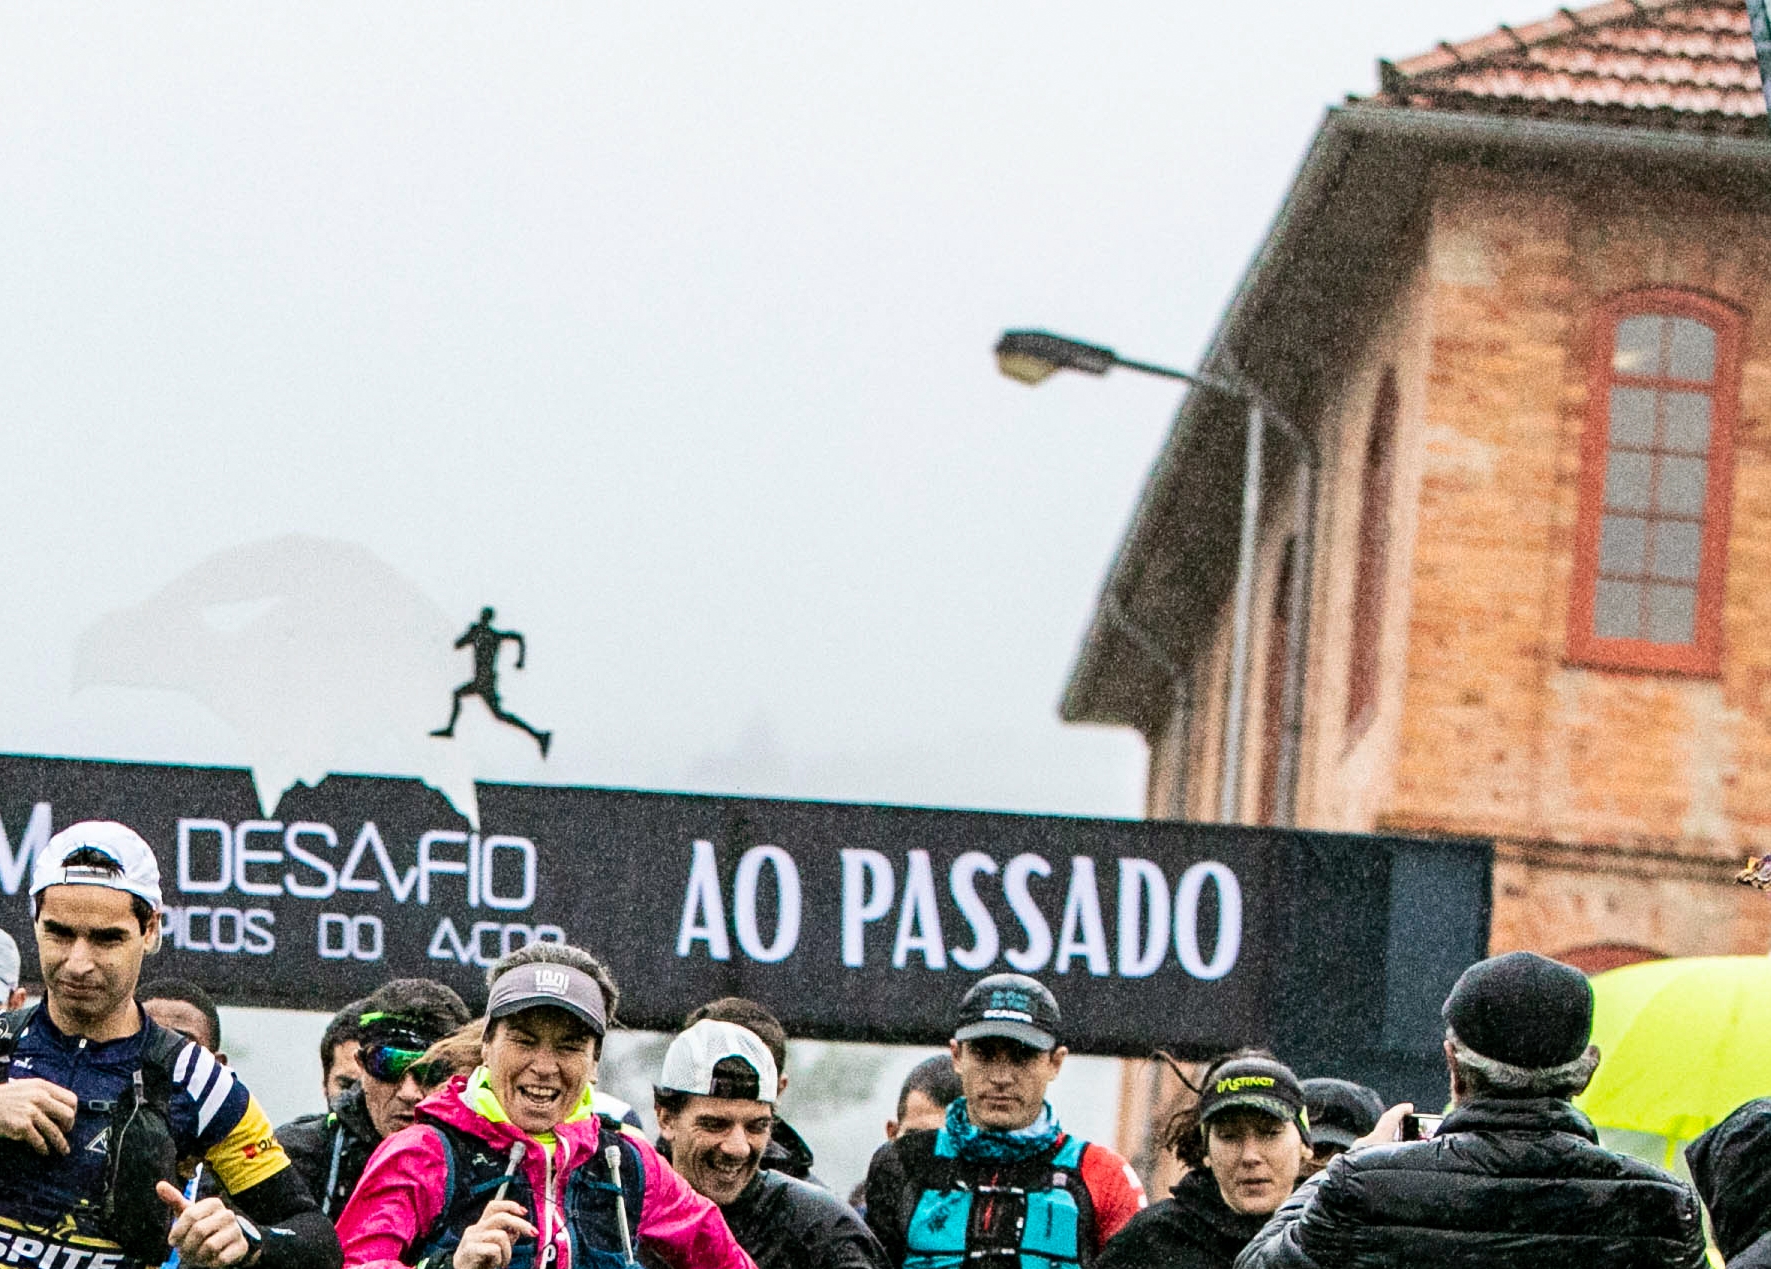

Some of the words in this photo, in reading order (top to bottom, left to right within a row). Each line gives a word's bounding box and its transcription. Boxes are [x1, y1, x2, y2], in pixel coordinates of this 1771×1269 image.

[177, 818, 537, 911] DESAFIO
[676, 839, 802, 964] AO
[840, 848, 1244, 981] PASSADO
[317, 912, 383, 962] DO
